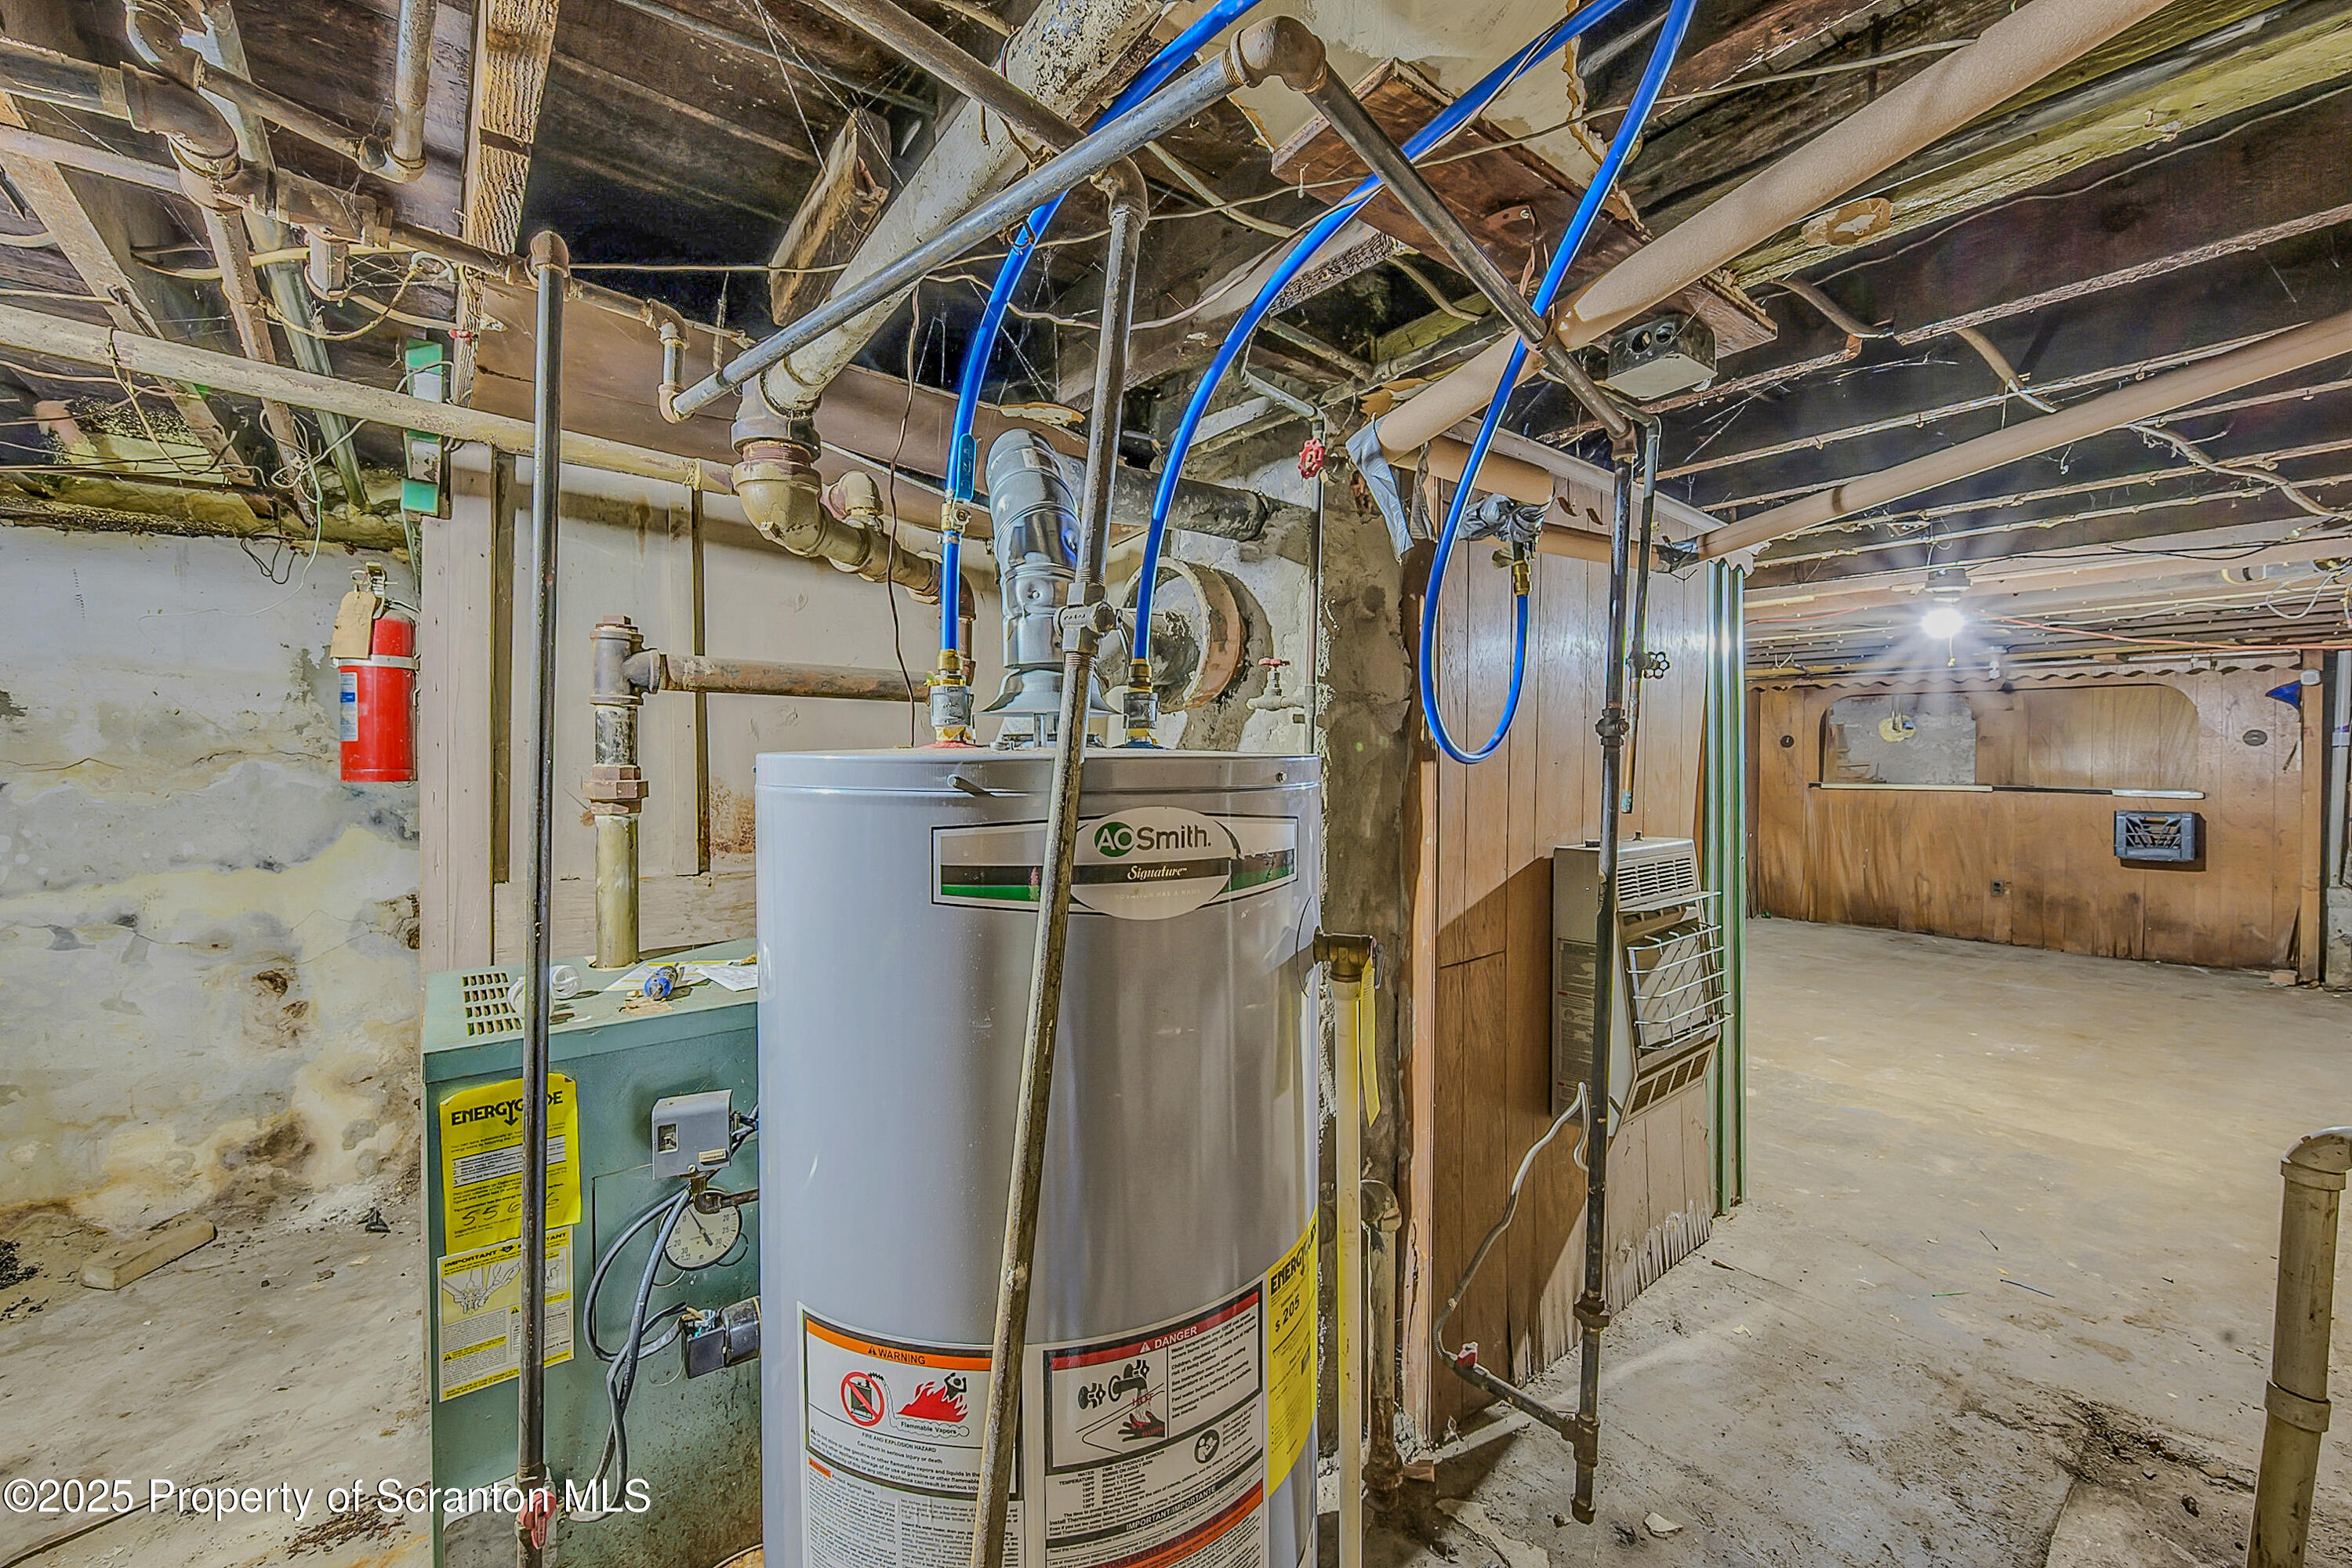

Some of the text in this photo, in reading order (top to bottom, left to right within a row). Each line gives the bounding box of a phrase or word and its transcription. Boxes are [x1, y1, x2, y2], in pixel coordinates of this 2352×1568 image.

[452, 1091, 564, 1126] ENERGYGE
[445, 1250, 498, 1268] IMPORTANT
[1154, 1326, 1197, 1349] DANGER
[879, 1348, 926, 1365] WARNING
[1187, 1362, 1199, 1370] being
[1195, 1384, 1209, 1392] before
[1210, 1375, 1225, 1386] bathing
[1230, 1359, 1249, 1374] showering
[902, 1421, 957, 1435] Flammable Vapors
[885, 1439, 913, 1449] EXPLOSION
[1059, 1476, 1094, 1486] TEMPERATURE
[1127, 1485, 1216, 1530] IMPORTANT/IMPORTANTE
[1067, 1512, 1102, 1523] Thermostatic
